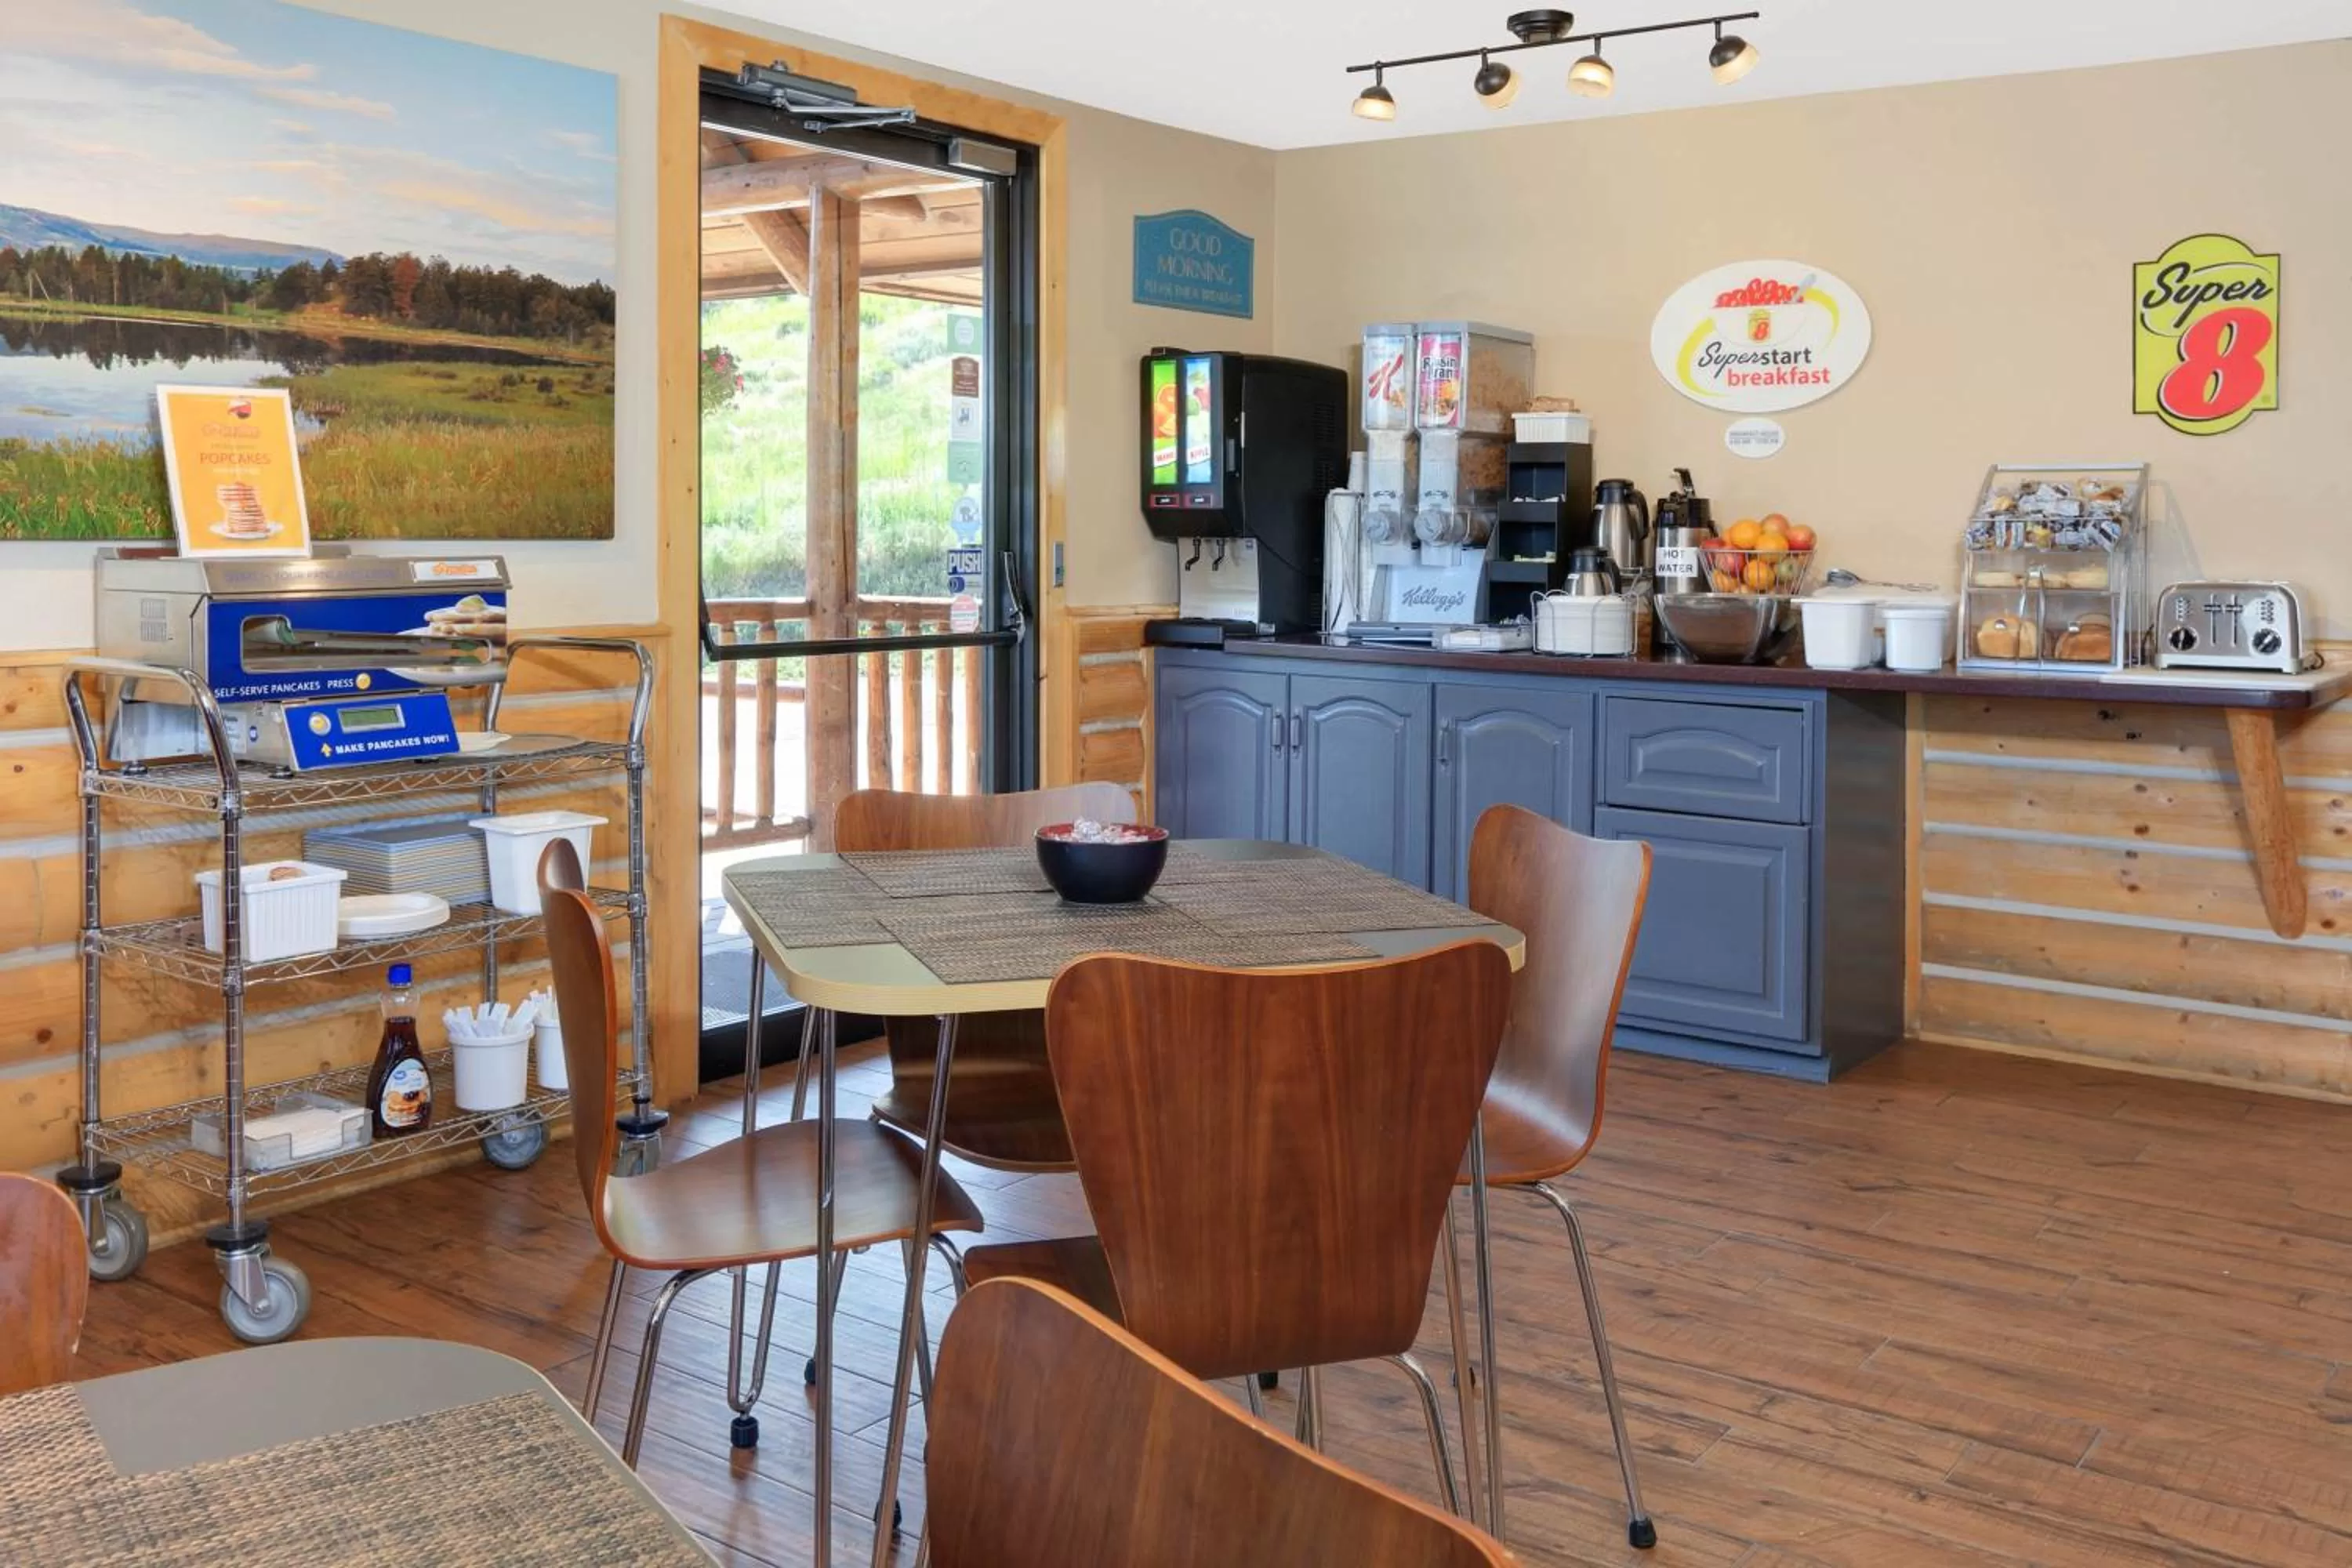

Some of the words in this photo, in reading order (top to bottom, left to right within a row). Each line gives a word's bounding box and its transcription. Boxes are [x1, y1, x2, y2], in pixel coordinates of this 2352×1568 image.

[1170, 227, 1221, 256] GOOD
[1157, 255, 1233, 285] MORNING
[2142, 261, 2274, 328] Super
[2158, 306, 2273, 422] 8
[1727, 365, 1831, 387] breakfast
[200, 452, 271, 466] POPCAKES
[949, 552, 981, 573] PUSH
[1663, 550, 1686, 559] HOT
[1658, 564, 1693, 573] WATER
[1401, 584, 1466, 612] Kellogg's
[214, 684, 269, 699] SELF-SERVE
[271, 681, 321, 694] PANCAKES
[327, 678, 354, 688] PRESS
[336, 742, 365, 754] MAKE
[368, 736, 421, 751] PANCAKES
